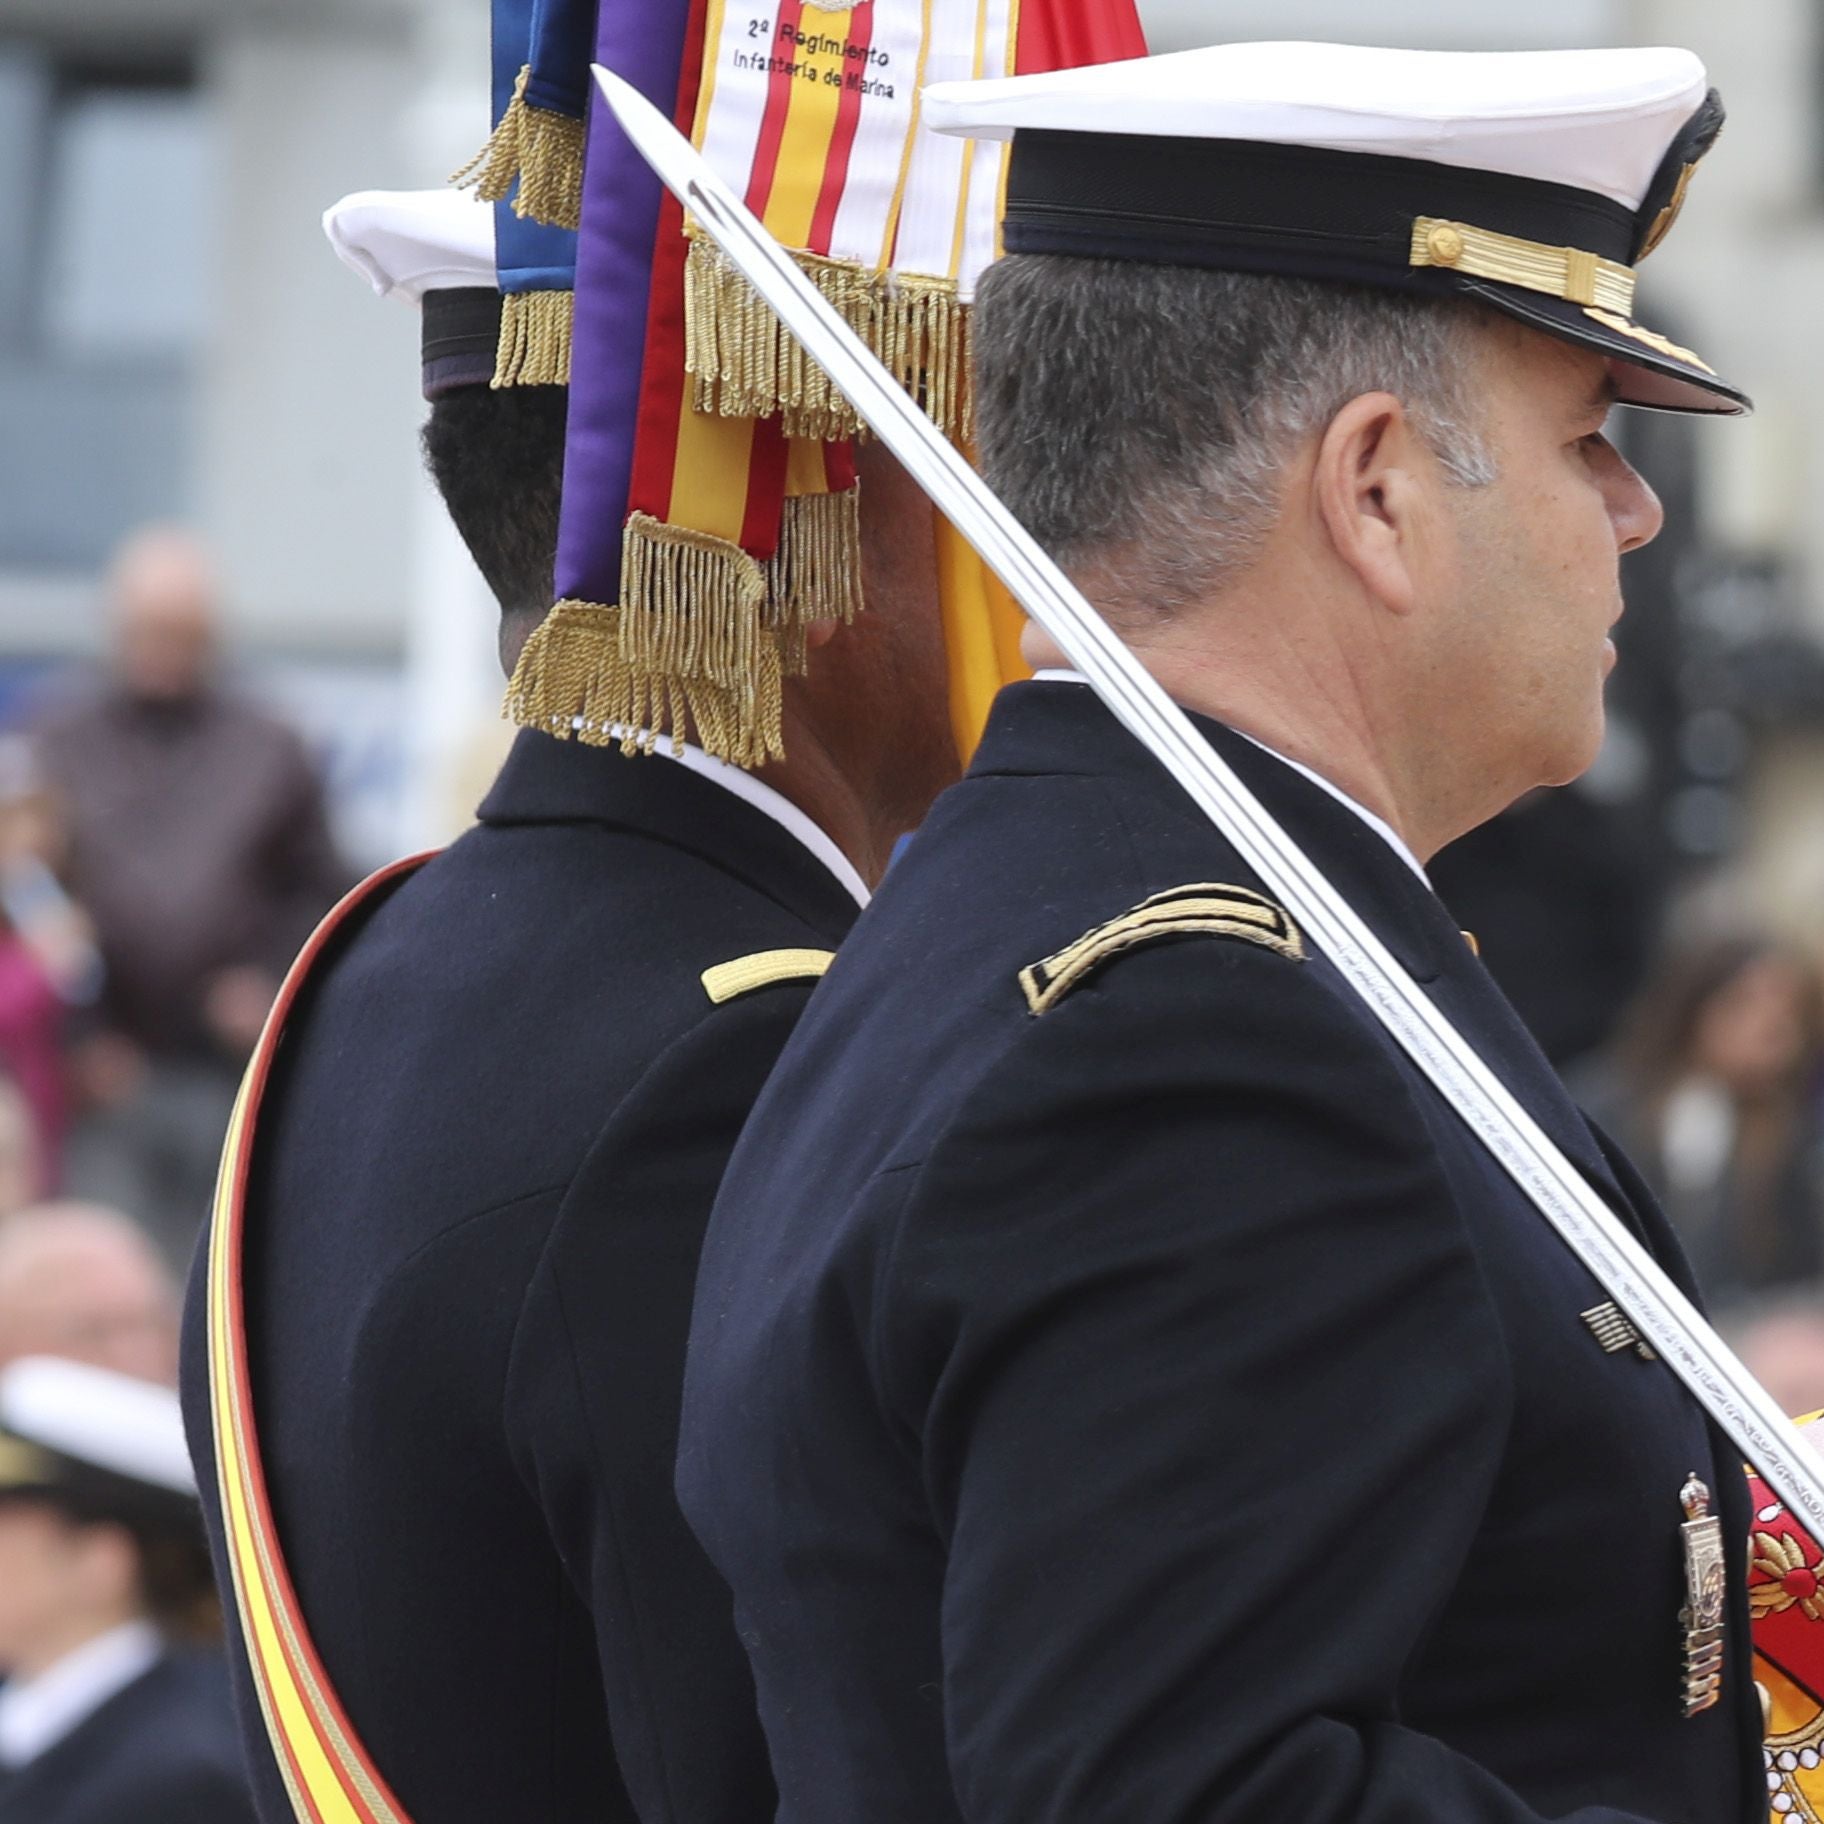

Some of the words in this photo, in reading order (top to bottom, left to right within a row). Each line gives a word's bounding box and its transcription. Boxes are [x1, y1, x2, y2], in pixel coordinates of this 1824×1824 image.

[780, 23, 890, 67] Regimiento
[823, 67, 842, 87] de
[846, 72, 895, 99] Marina
